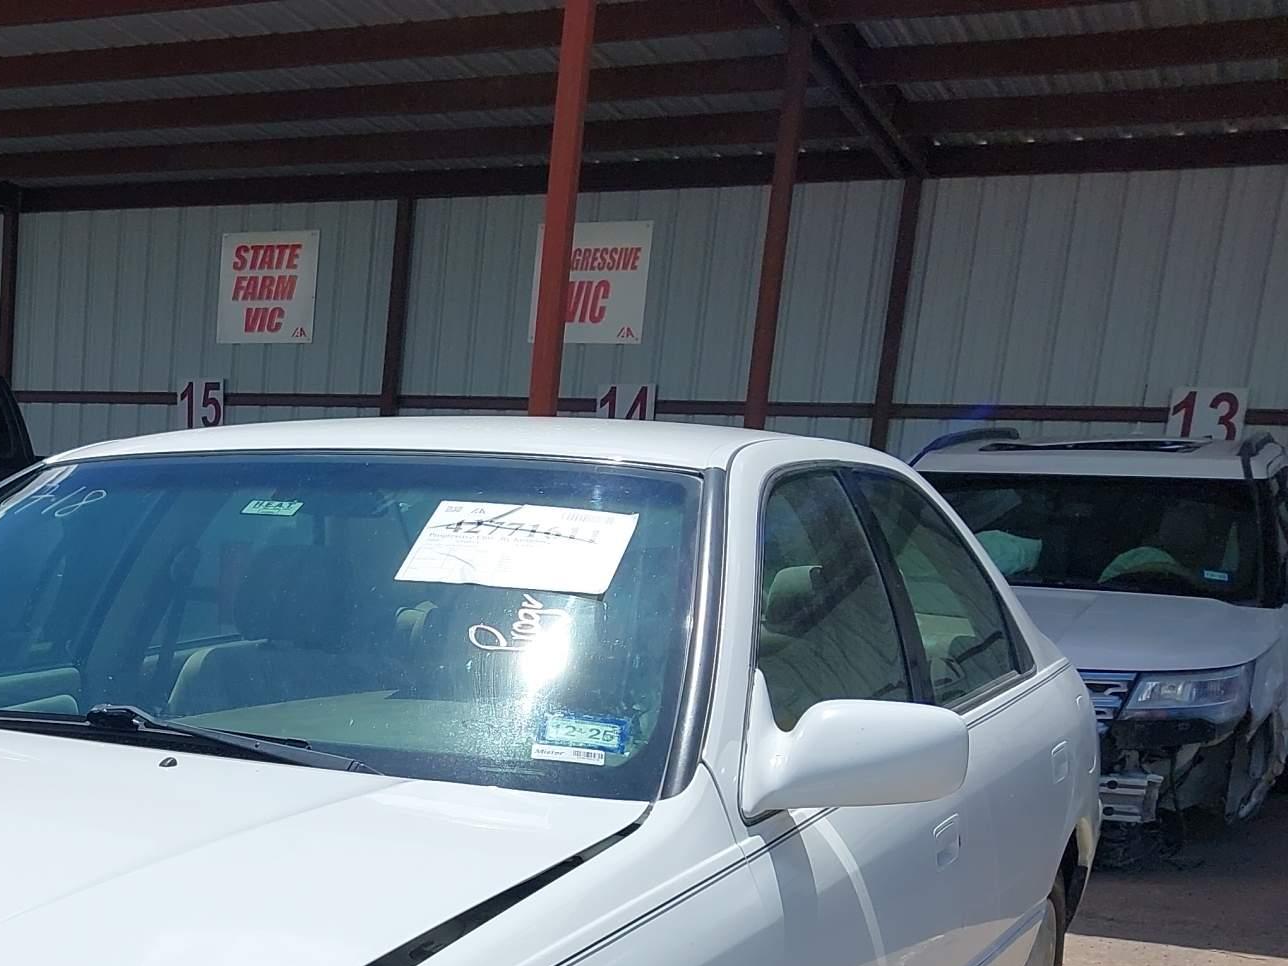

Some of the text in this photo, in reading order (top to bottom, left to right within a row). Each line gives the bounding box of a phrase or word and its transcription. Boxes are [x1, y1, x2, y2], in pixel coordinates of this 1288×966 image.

[232, 244, 302, 271] STATE
[571, 247, 642, 272] GRESSIVE
[232, 275, 298, 301] FARM
[566, 279, 610, 323] VIC
[244, 306, 285, 333] VIC
[181, 381, 222, 429] 15
[599, 385, 649, 420] 14
[1172, 388, 1239, 441] 13
